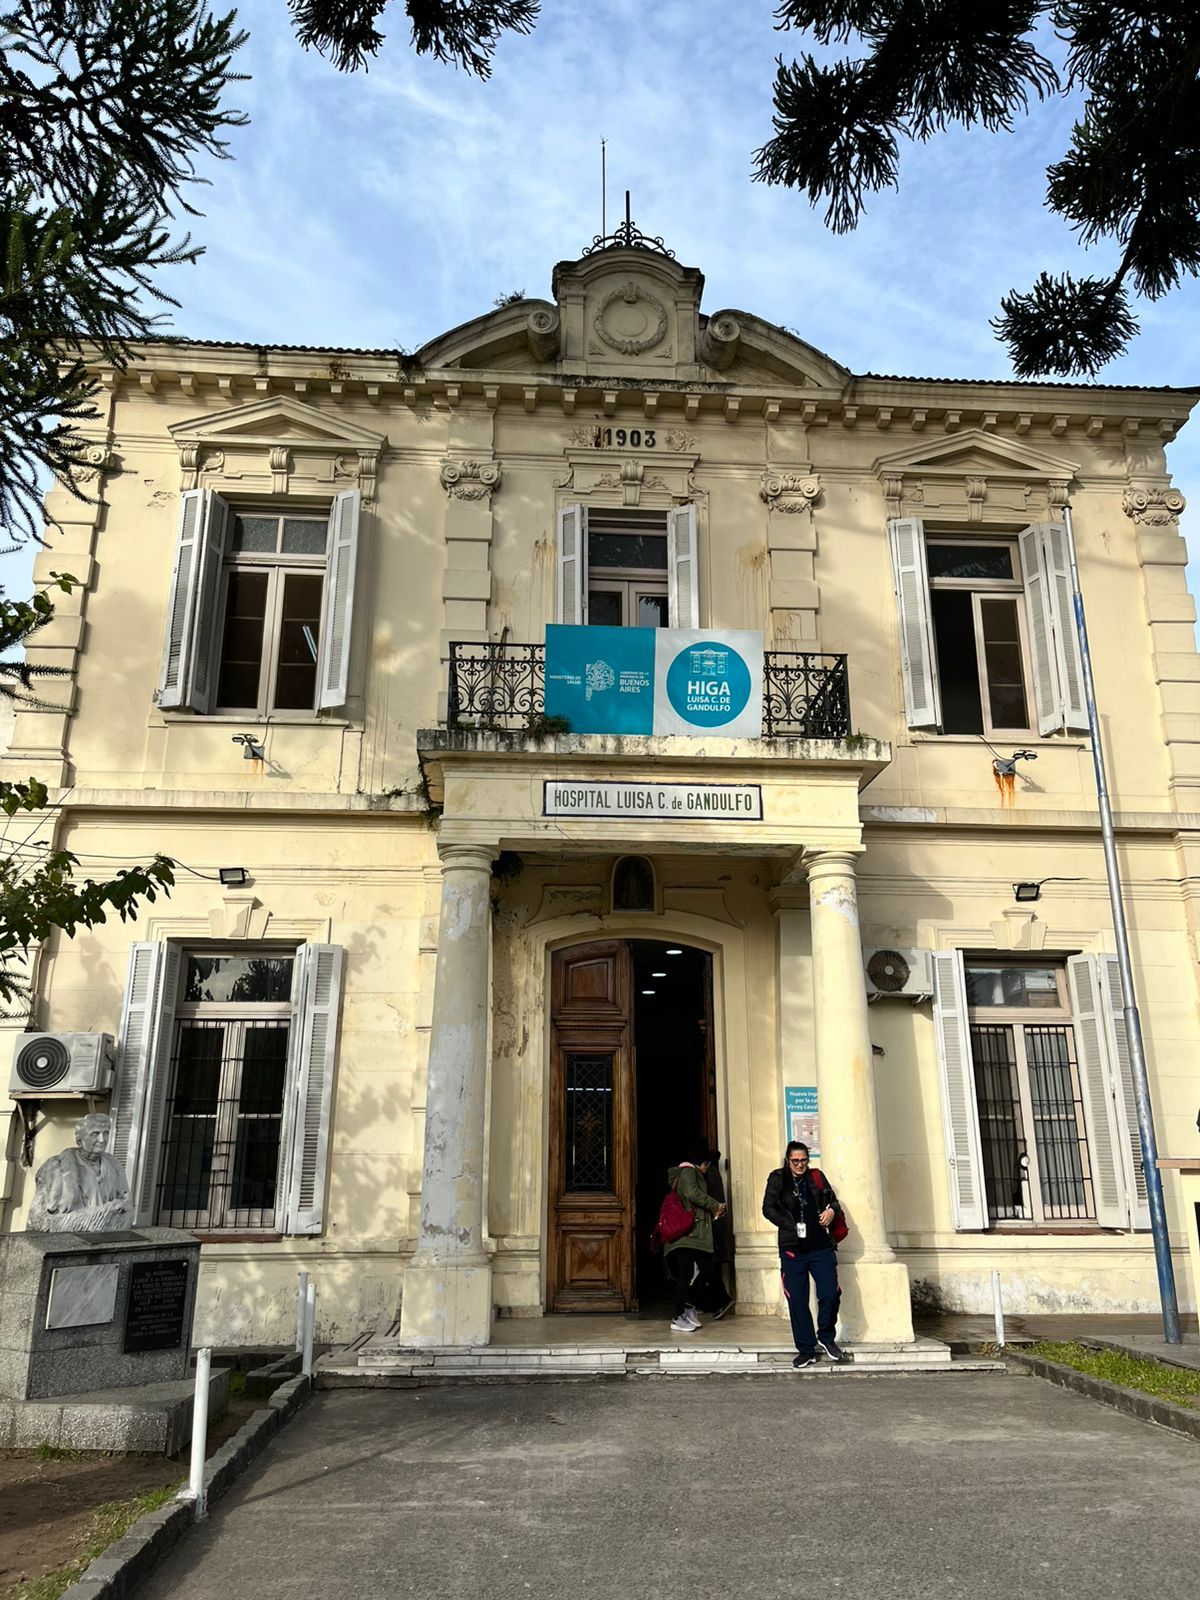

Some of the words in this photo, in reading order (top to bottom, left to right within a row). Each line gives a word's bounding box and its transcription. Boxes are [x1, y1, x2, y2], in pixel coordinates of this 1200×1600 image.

[605, 428, 656, 448] 1903
[687, 680, 731, 696] HIGA
[554, 790, 611, 808] HOSPITAL
[617, 791, 654, 809] LUISA
[658, 792, 668, 809] C.
[672, 796, 682, 809] de
[687, 792, 752, 811] GANDULFO
